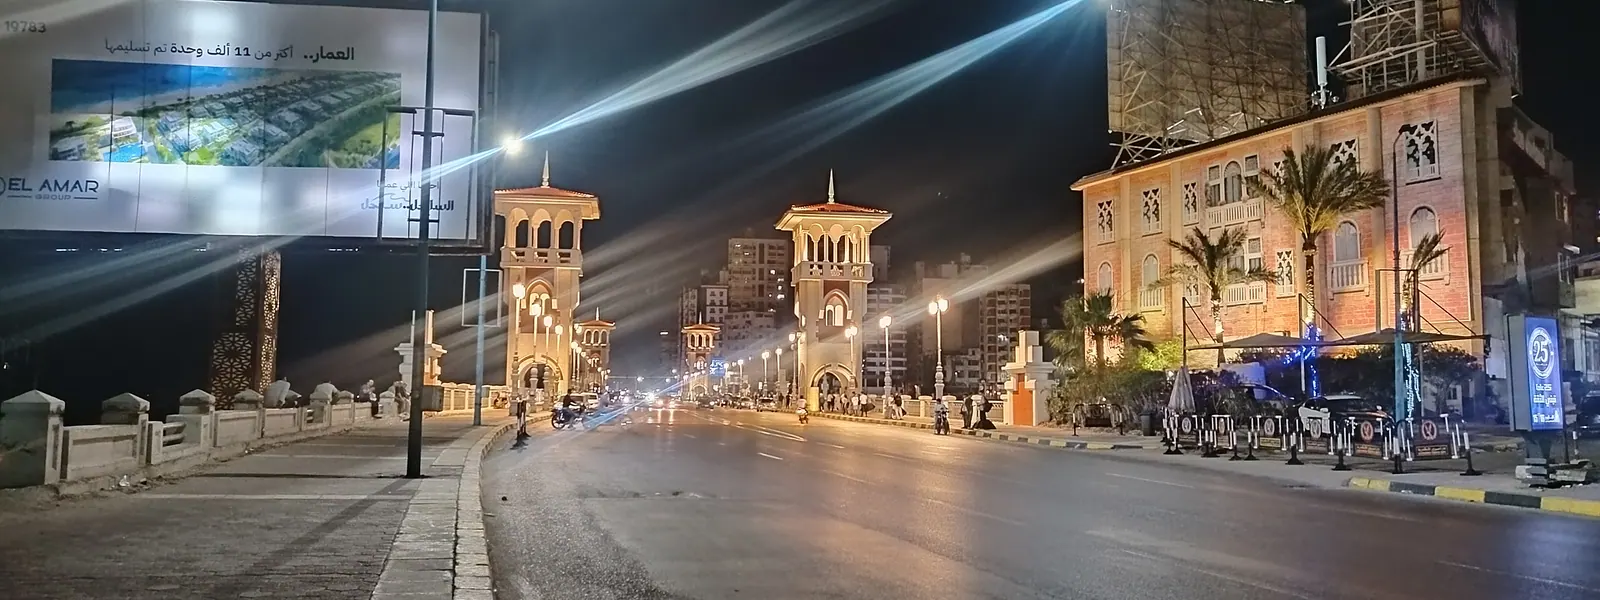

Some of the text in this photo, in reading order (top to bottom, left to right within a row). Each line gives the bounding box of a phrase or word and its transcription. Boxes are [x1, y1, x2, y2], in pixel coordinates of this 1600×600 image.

[4, 20, 47, 33] 19783
[104, 37, 150, 54] تسليمها
[153, 43, 168, 56] تم
[170, 43, 203, 57] وحدة
[206, 42, 230, 56] ألف
[234, 47, 251, 56] 11
[254, 50, 272, 60] من
[8, 178, 99, 192] EL AMAR
[1534, 340, 1549, 362] 25
